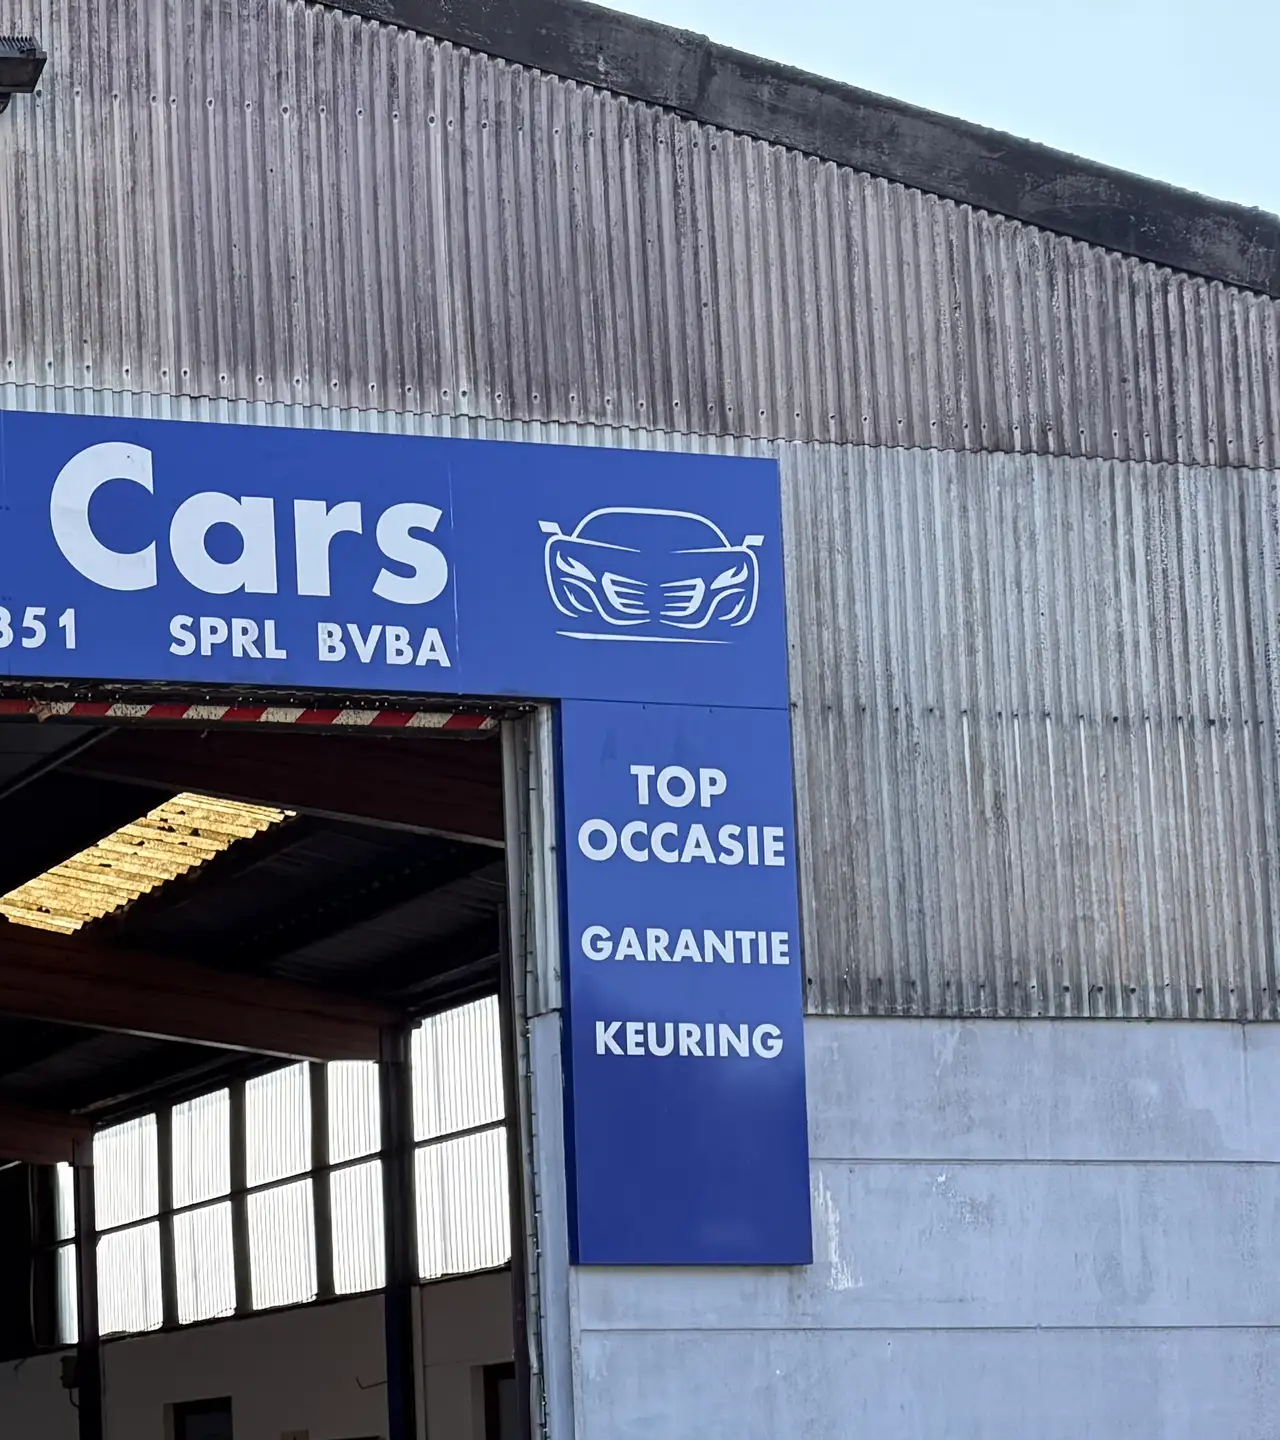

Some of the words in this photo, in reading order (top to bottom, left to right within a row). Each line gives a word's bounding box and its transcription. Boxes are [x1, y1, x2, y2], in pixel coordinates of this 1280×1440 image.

[49, 440, 450, 605] Cars
[169, 614, 287, 660] SPRL
[317, 622, 451, 668] BVBA
[630, 764, 727, 808] TOP
[577, 818, 785, 866] OCCASIE
[581, 925, 790, 965] GARANTIE
[595, 1021, 784, 1059] KEURING
